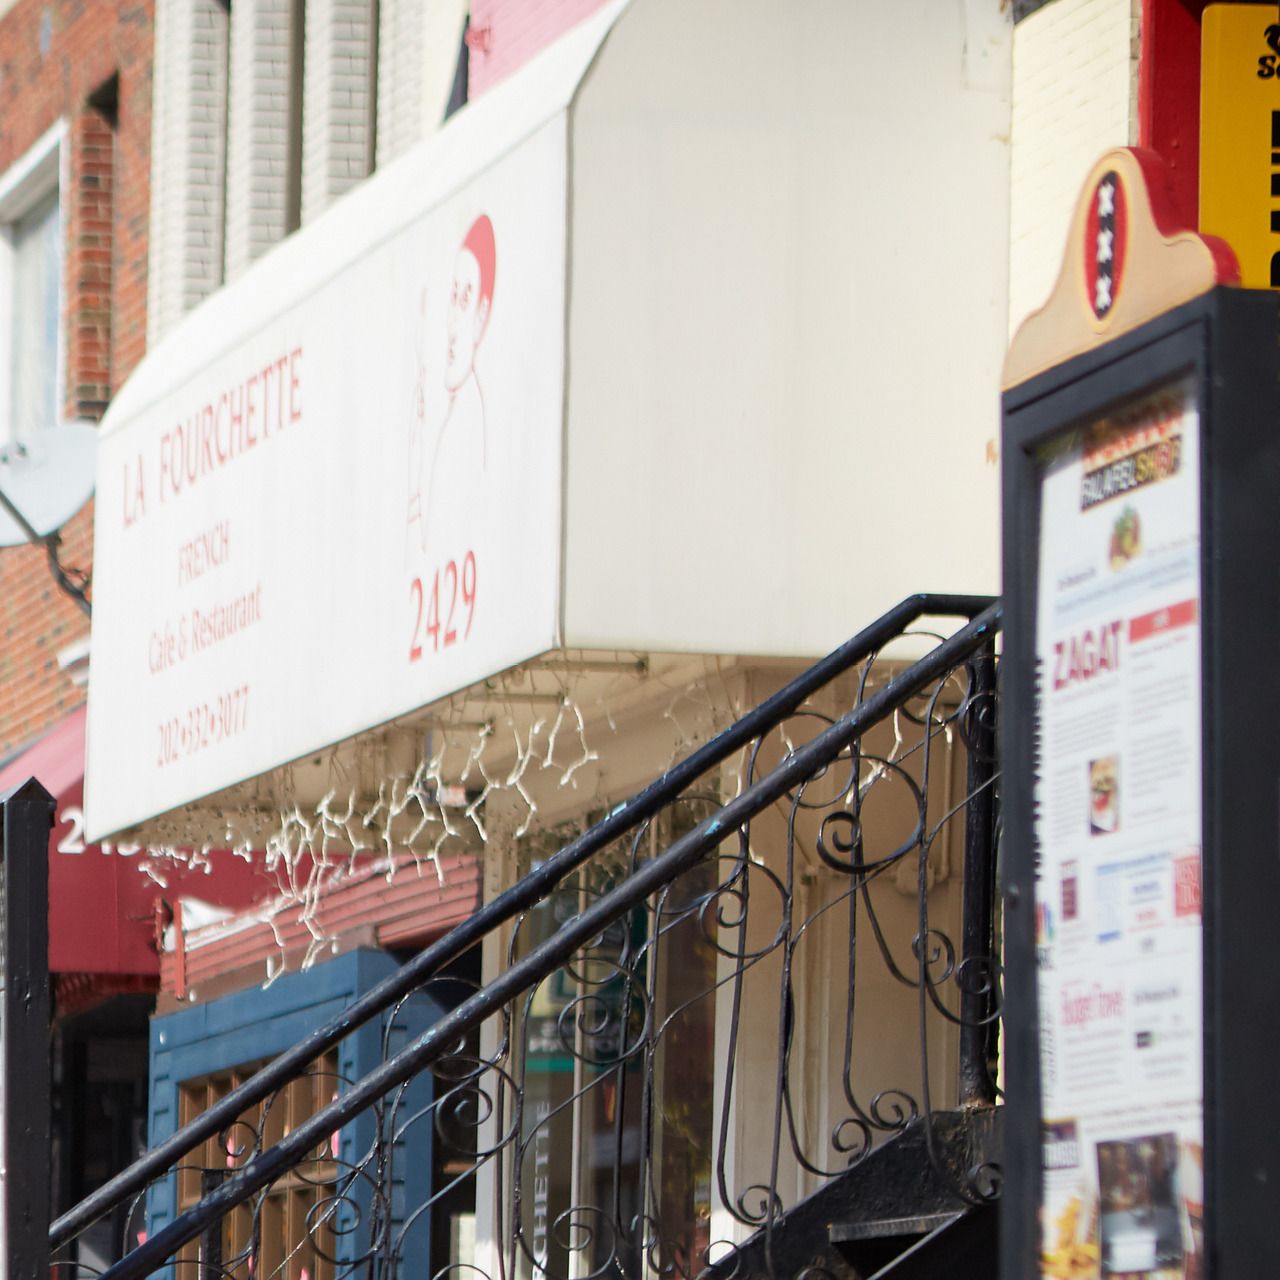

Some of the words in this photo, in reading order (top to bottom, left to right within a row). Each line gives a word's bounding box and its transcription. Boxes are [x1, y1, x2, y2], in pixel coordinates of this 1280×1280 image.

[122, 454, 147, 529] LA
[160, 347, 303, 504] FOURCHETTE
[178, 519, 231, 588] FRENCH
[178, 614, 188, 661] &
[191, 579, 263, 653] Restaurant
[408, 549, 478, 662] 2429
[1053, 619, 1122, 691] ZAGAT
